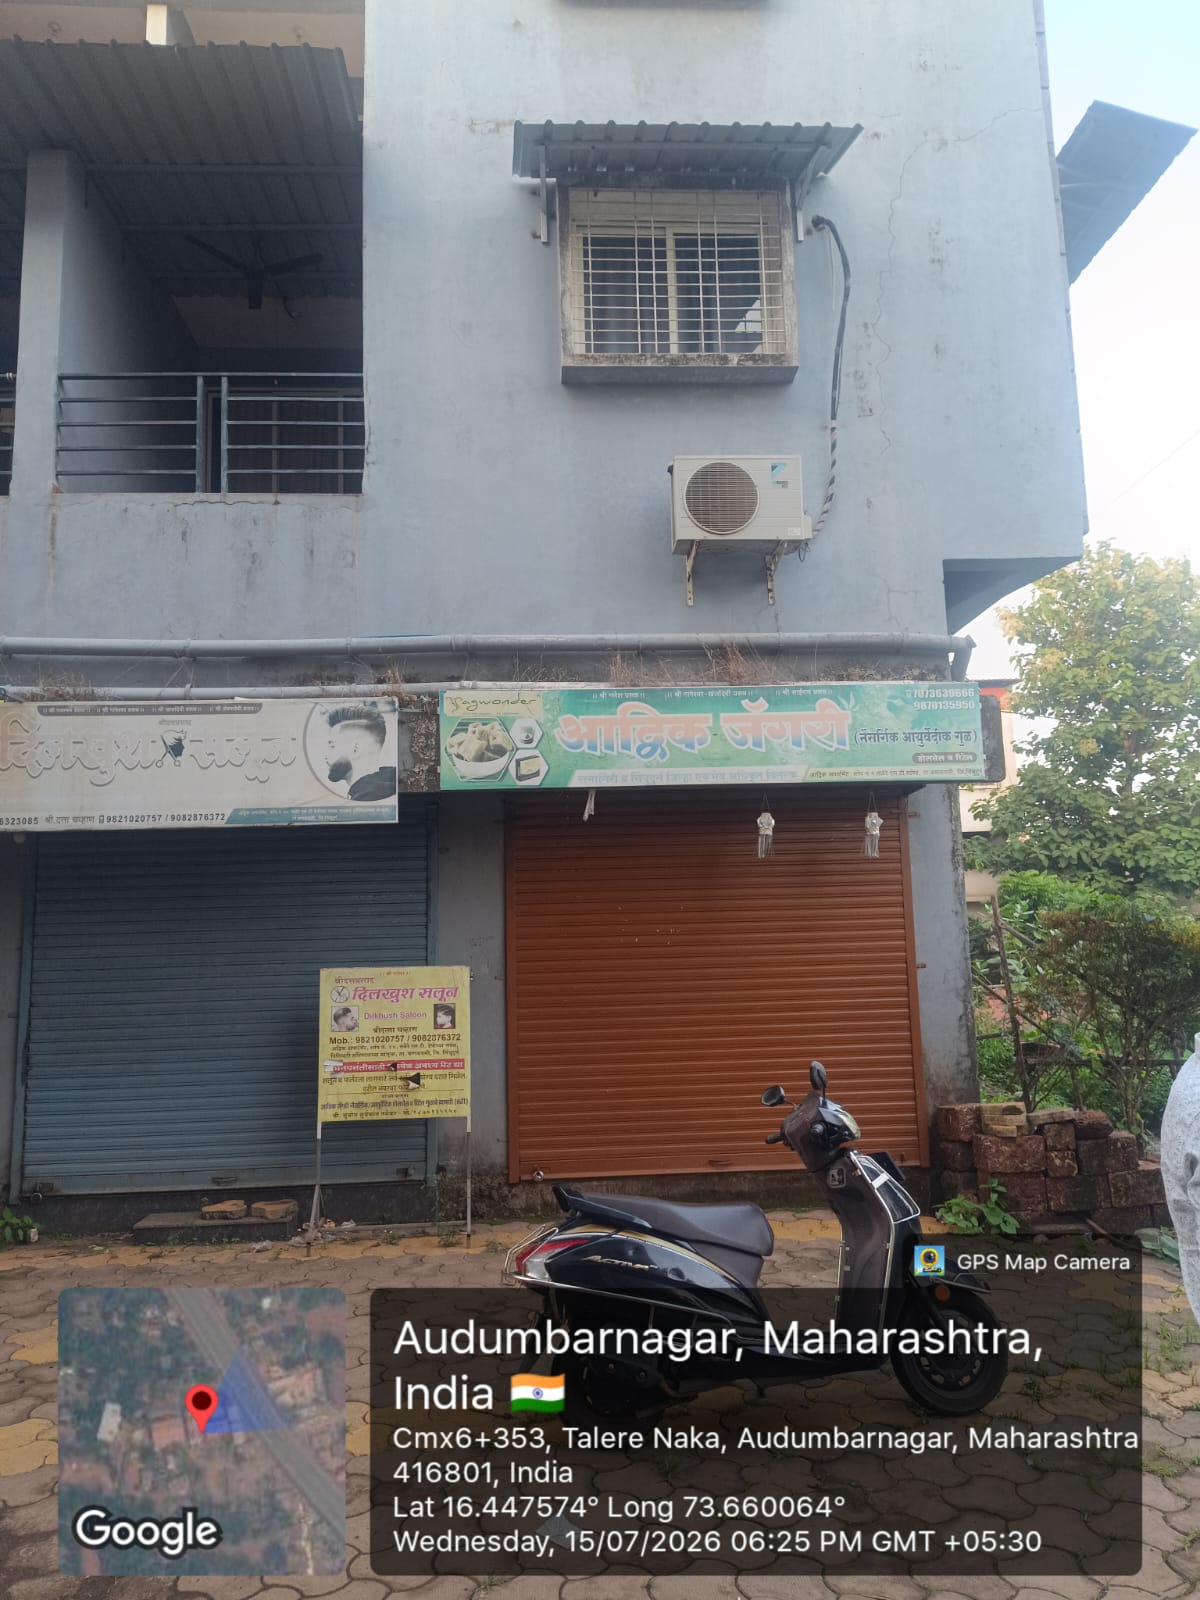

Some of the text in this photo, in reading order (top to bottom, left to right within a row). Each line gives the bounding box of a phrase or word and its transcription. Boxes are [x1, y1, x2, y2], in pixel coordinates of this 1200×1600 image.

[106, 813, 163, 824] 9821020757
[170, 812, 226, 823] 9082876372
[352, 985, 459, 1004] दिलखुश सलून
[355, 1034, 405, 1044] 9821020757
[411, 1033, 461, 1043] 9082876372
